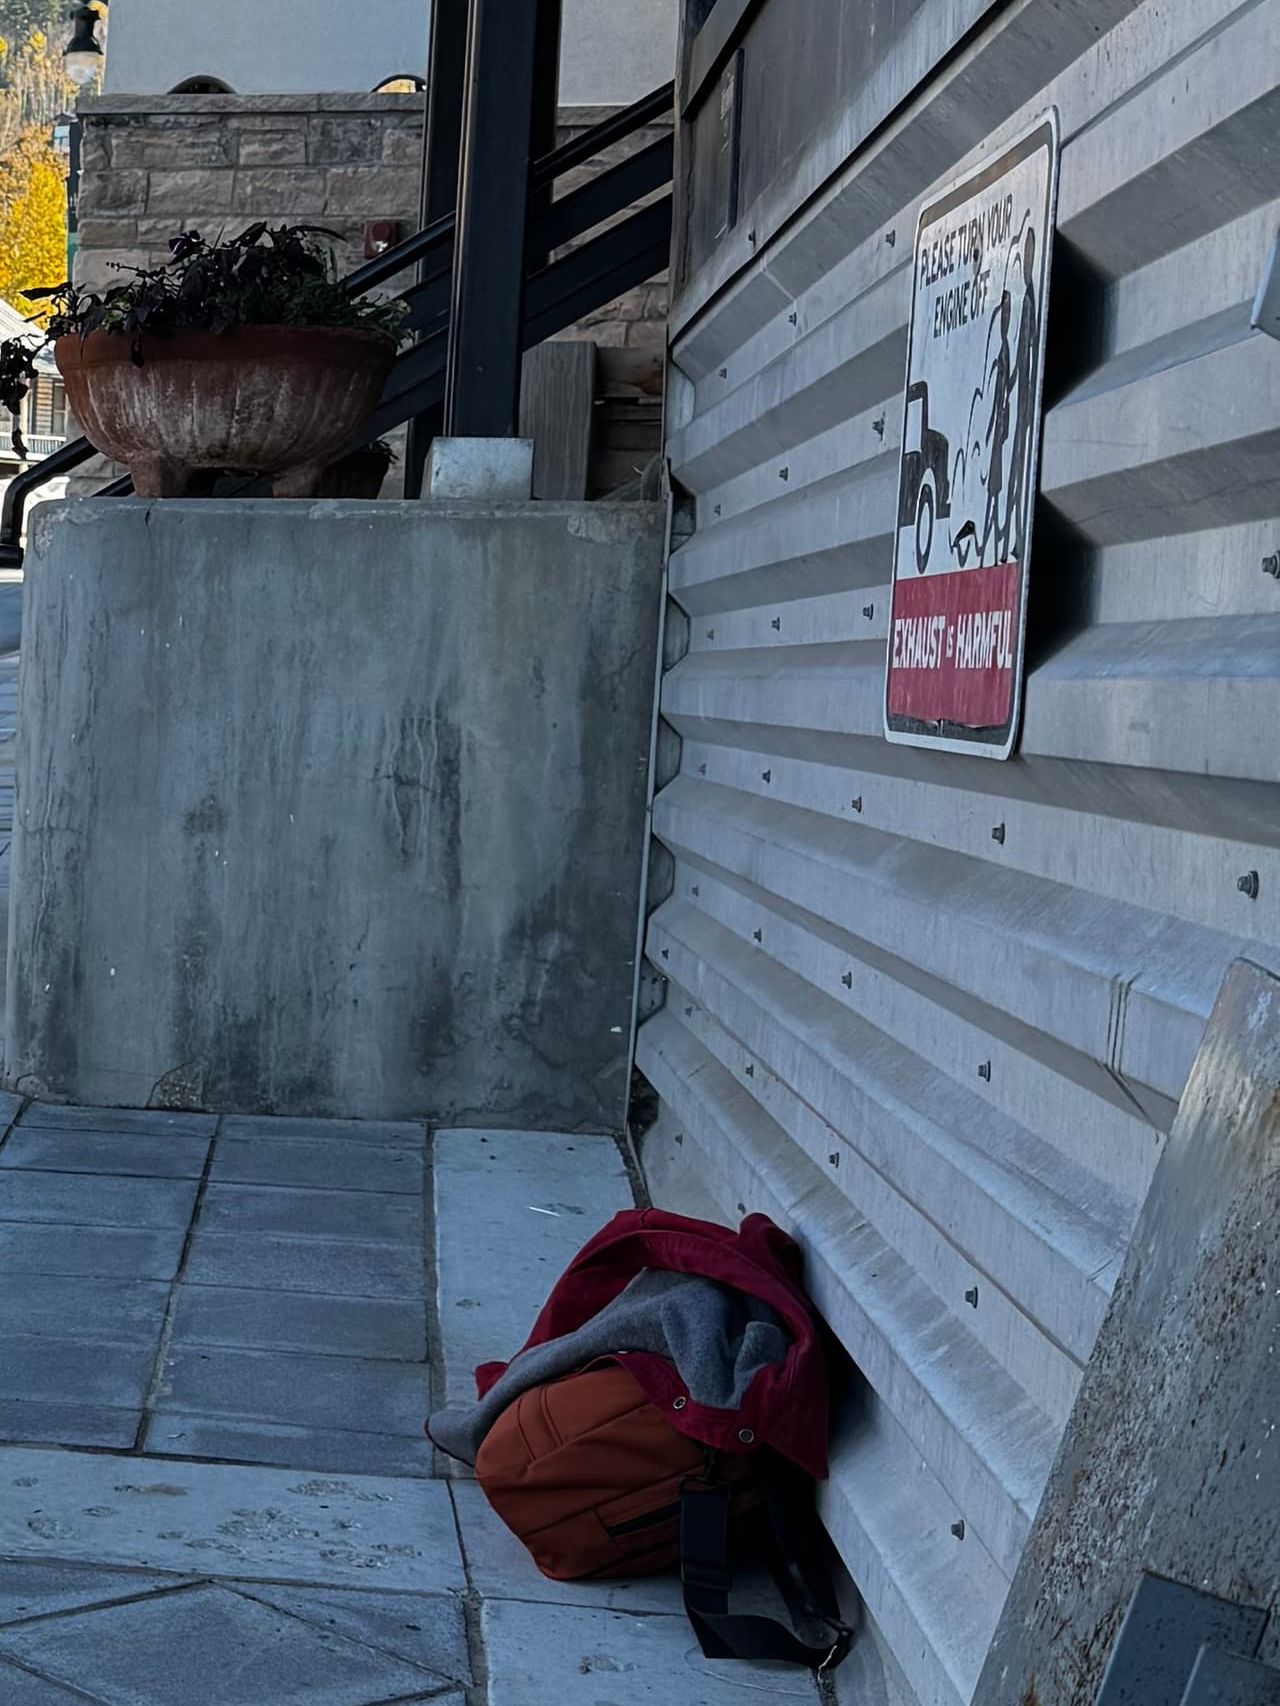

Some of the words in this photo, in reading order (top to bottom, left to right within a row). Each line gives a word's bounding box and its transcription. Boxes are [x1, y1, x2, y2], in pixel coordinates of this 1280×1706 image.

[919, 230, 957, 291] PLEASE
[986, 193, 1013, 252] YOUR
[933, 280, 971, 339] ENGINE
[970, 268, 991, 321] OFF
[892, 615, 946, 669] EXHAUST
[954, 610, 1013, 669] HARMFUL
